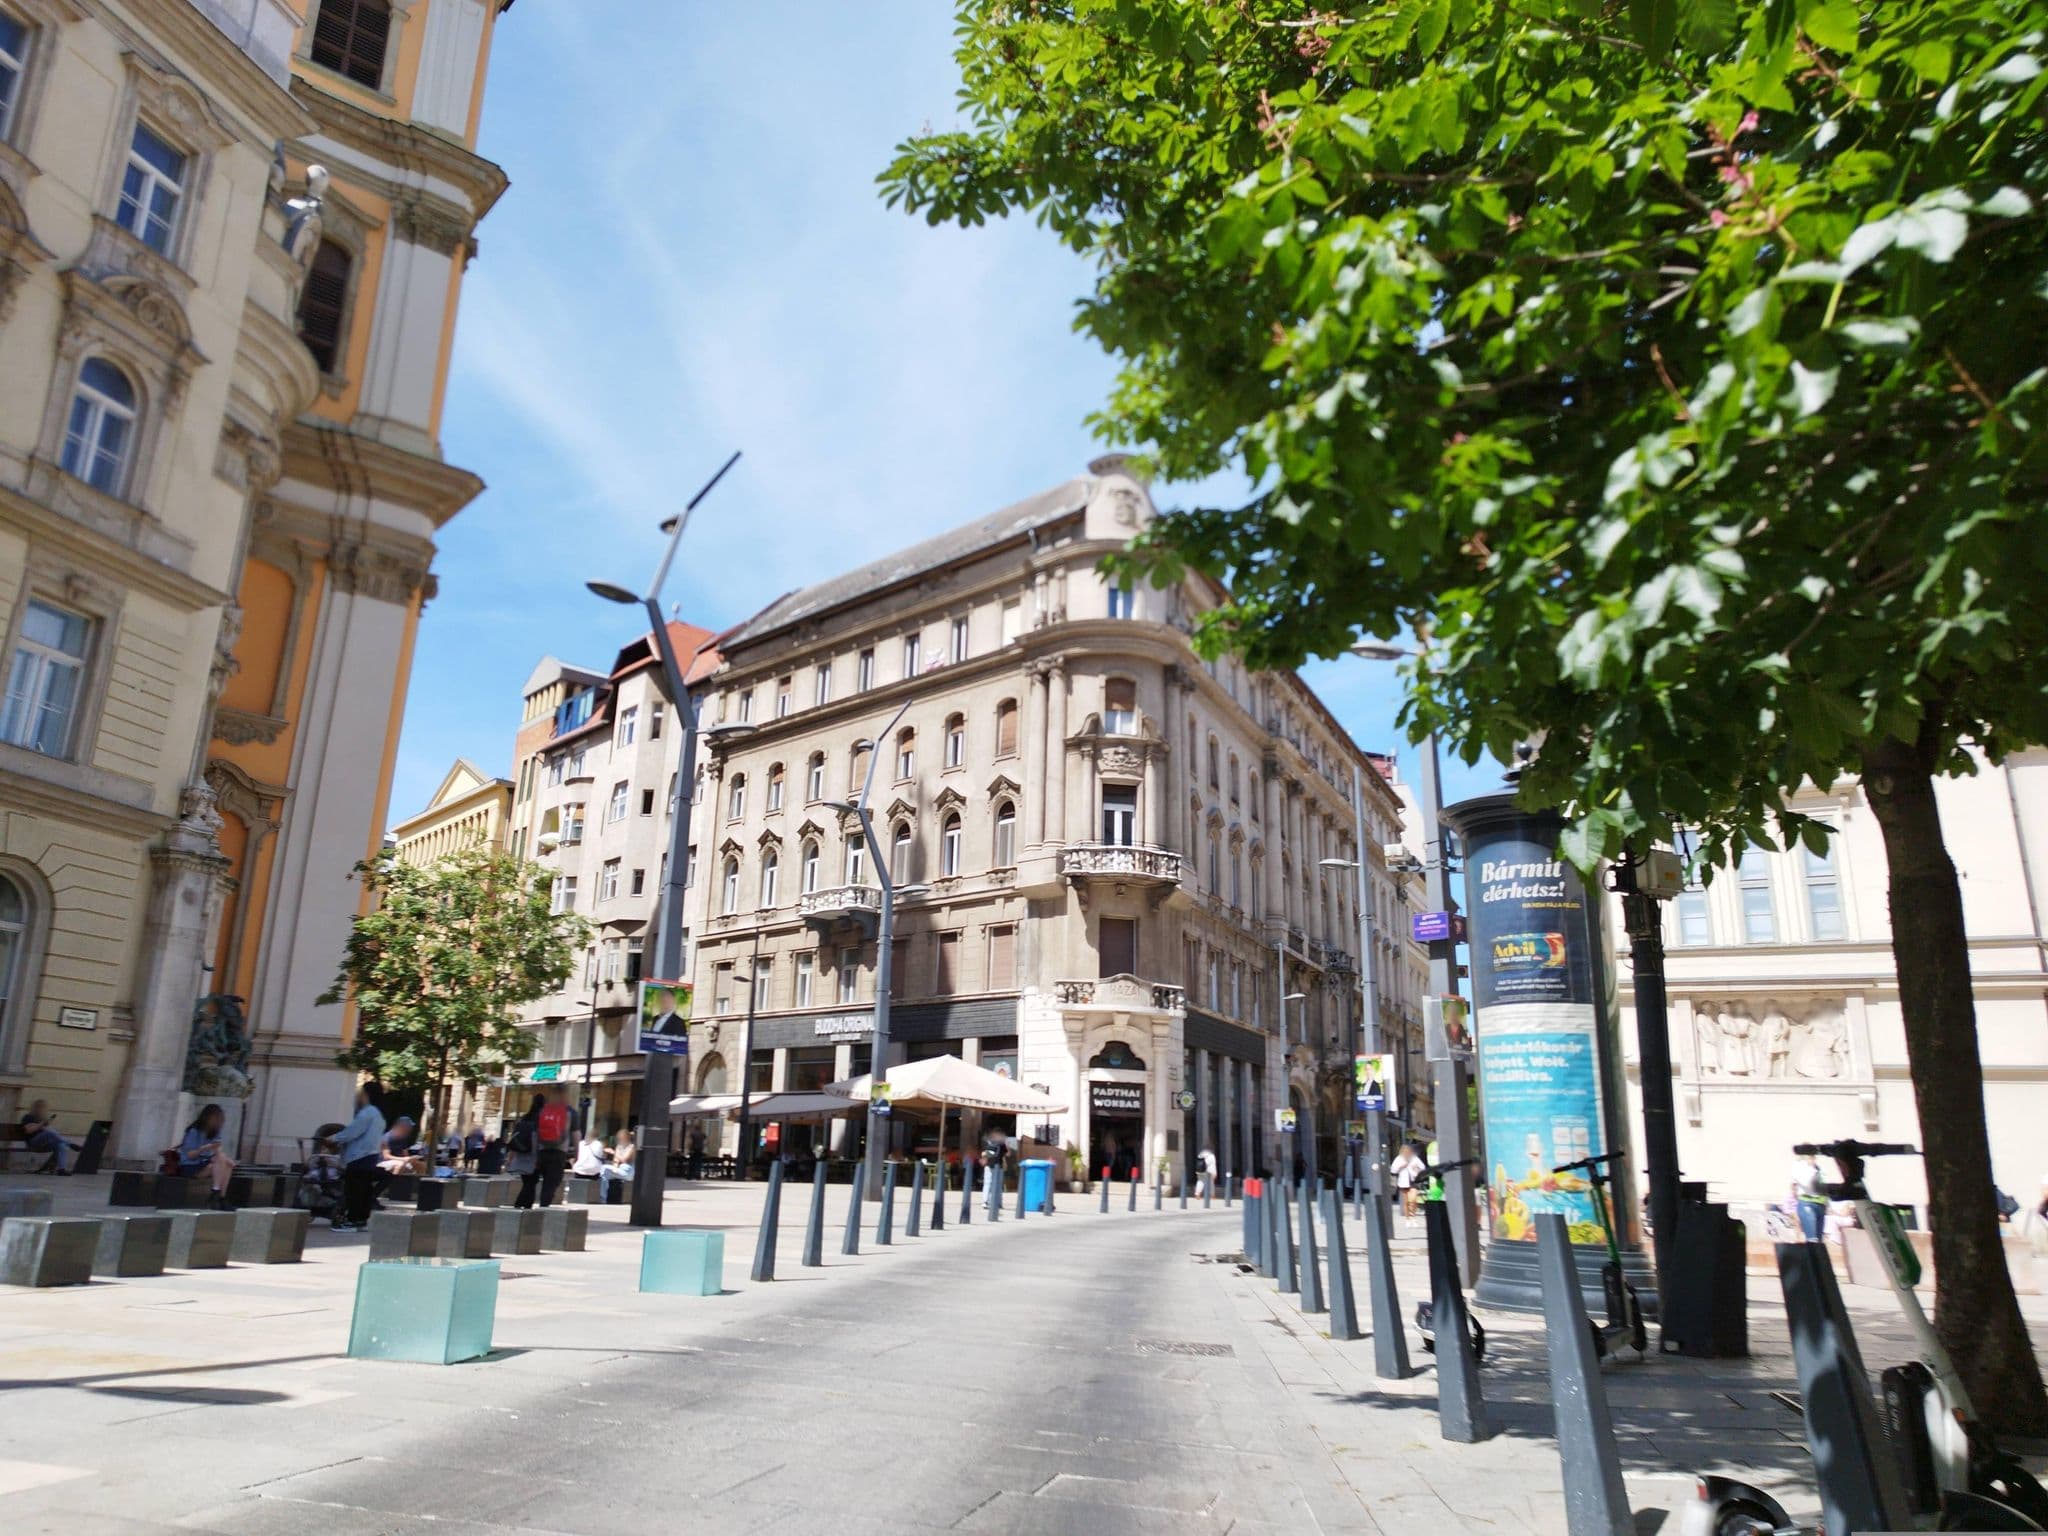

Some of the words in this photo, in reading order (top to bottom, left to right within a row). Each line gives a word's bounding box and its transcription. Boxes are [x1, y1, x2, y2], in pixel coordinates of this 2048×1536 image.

[1481, 857, 1562, 884] Bármit
[1482, 881, 1565, 903] elérhetsz!
[1494, 941, 1536, 957] Advil
[1092, 1087, 1140, 1098] PADTHAI
